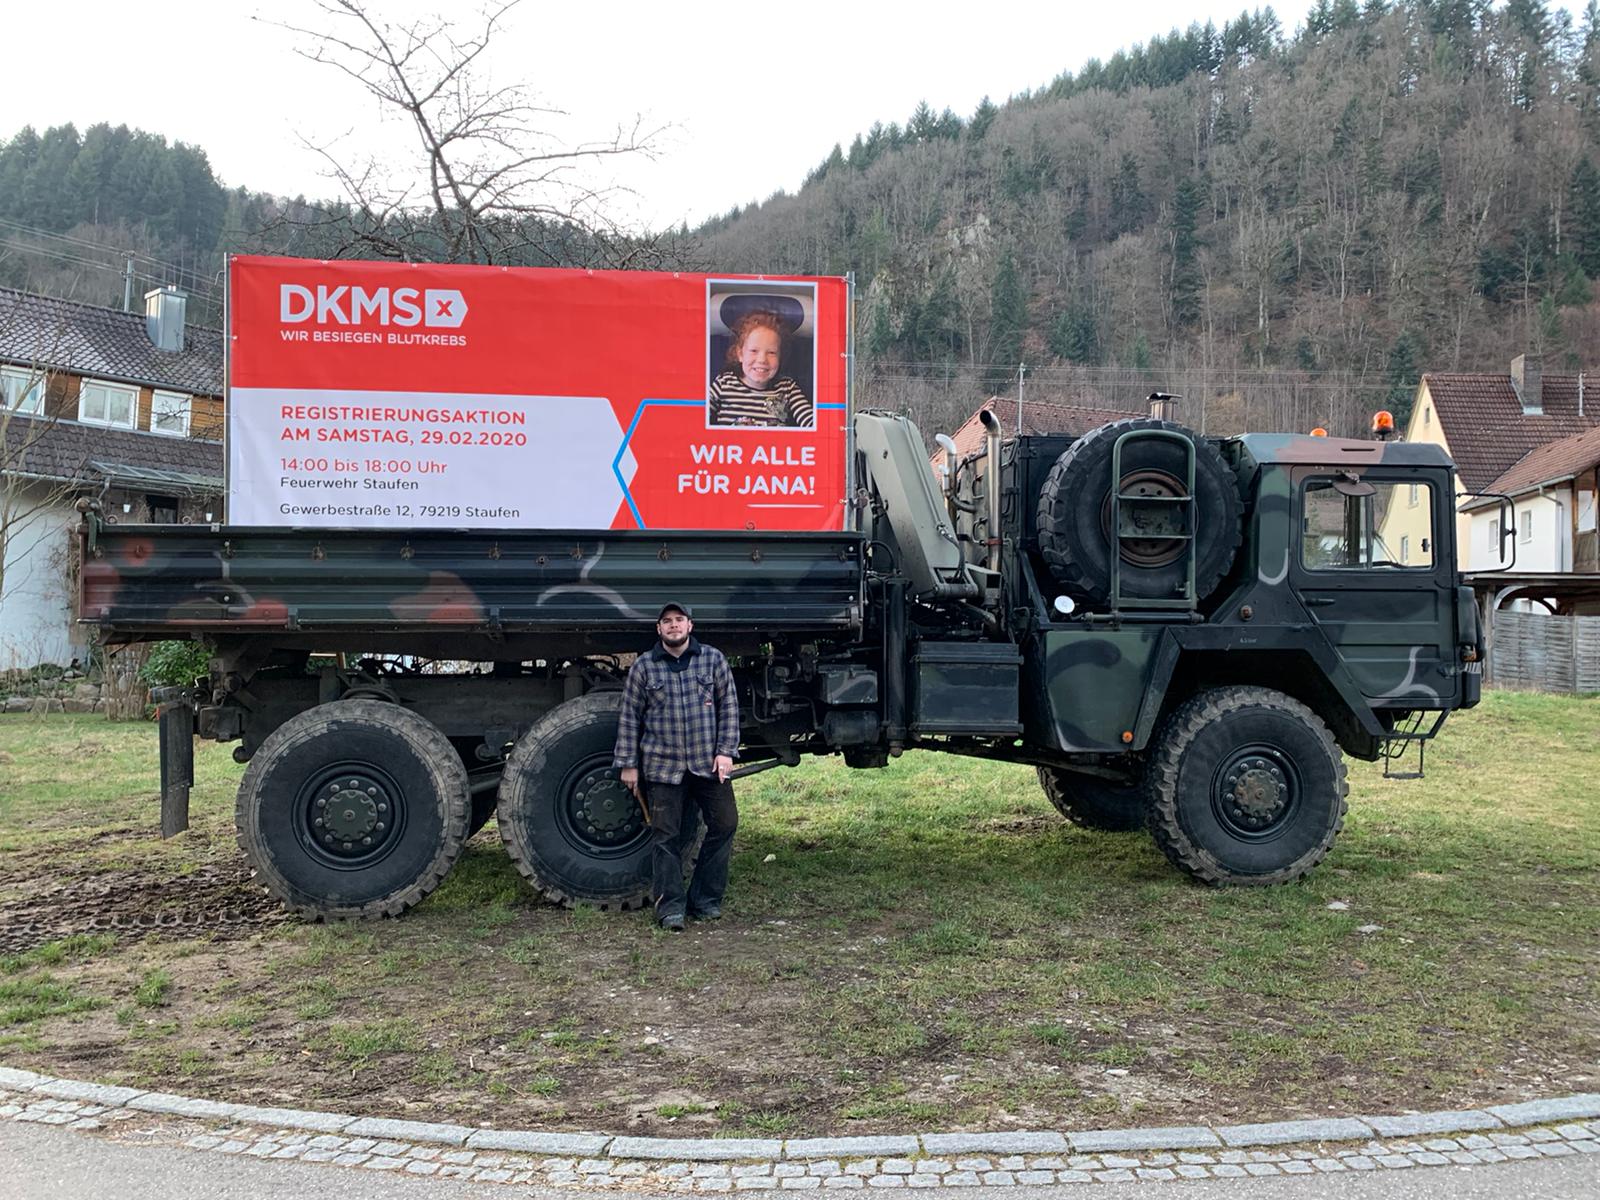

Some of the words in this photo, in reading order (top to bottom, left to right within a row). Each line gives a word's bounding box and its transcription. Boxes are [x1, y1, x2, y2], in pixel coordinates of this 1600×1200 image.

[280, 283, 423, 327] DKMS
[280, 330, 309, 341] WIR
[313, 330, 383, 344] BESIEGEN
[387, 333, 467, 347] BLUTKREBS
[281, 405, 525, 425] REGISTRIERUNGSAKTION
[280, 427, 310, 442] AM
[317, 427, 414, 446] SAMSTAG,
[420, 430, 527, 447] 29.02.2020
[689, 444, 743, 465] WIR
[750, 445, 816, 466] ALLE
[280, 457, 329, 472] 14:00
[334, 458, 360, 473] bis
[364, 459, 412, 474] 18:00
[417, 460, 448, 474] Uhr
[280, 476, 359, 489] Feuerwehr
[363, 478, 419, 490] Staufen
[678, 469, 730, 495] FÜR
[737, 475, 815, 496] JANA!
[279, 503, 391, 516] Gewerbestraße
[395, 504, 415, 519] 12,
[419, 505, 461, 518] 79219
[465, 506, 520, 518] Staufen
